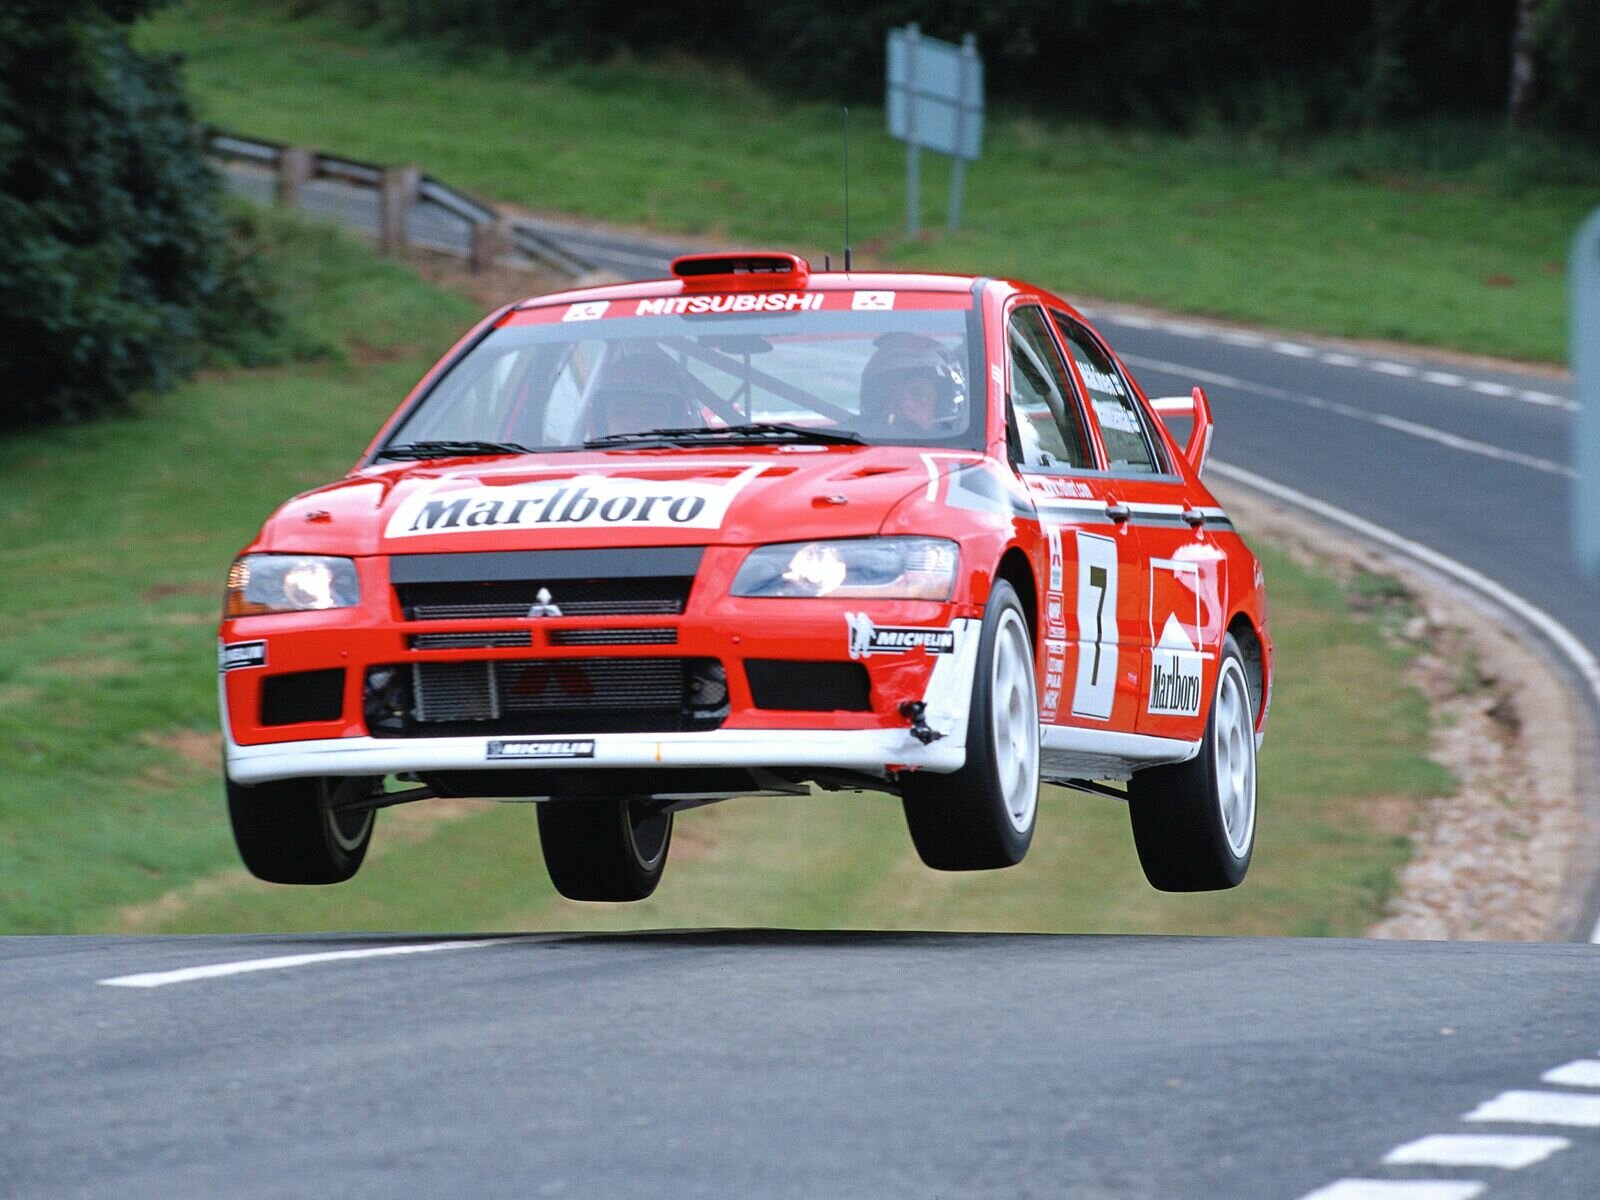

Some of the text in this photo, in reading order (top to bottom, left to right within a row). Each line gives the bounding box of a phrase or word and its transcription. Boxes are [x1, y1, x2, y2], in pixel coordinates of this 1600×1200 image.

[635, 293, 824, 316] MITSUBISHI
[408, 487, 706, 531] Marlboro
[876, 631, 953, 648] MICHELIN
[1090, 565, 1107, 686] 7
[1150, 656, 1199, 711] Marlboro
[502, 742, 594, 754] MICHELIN
